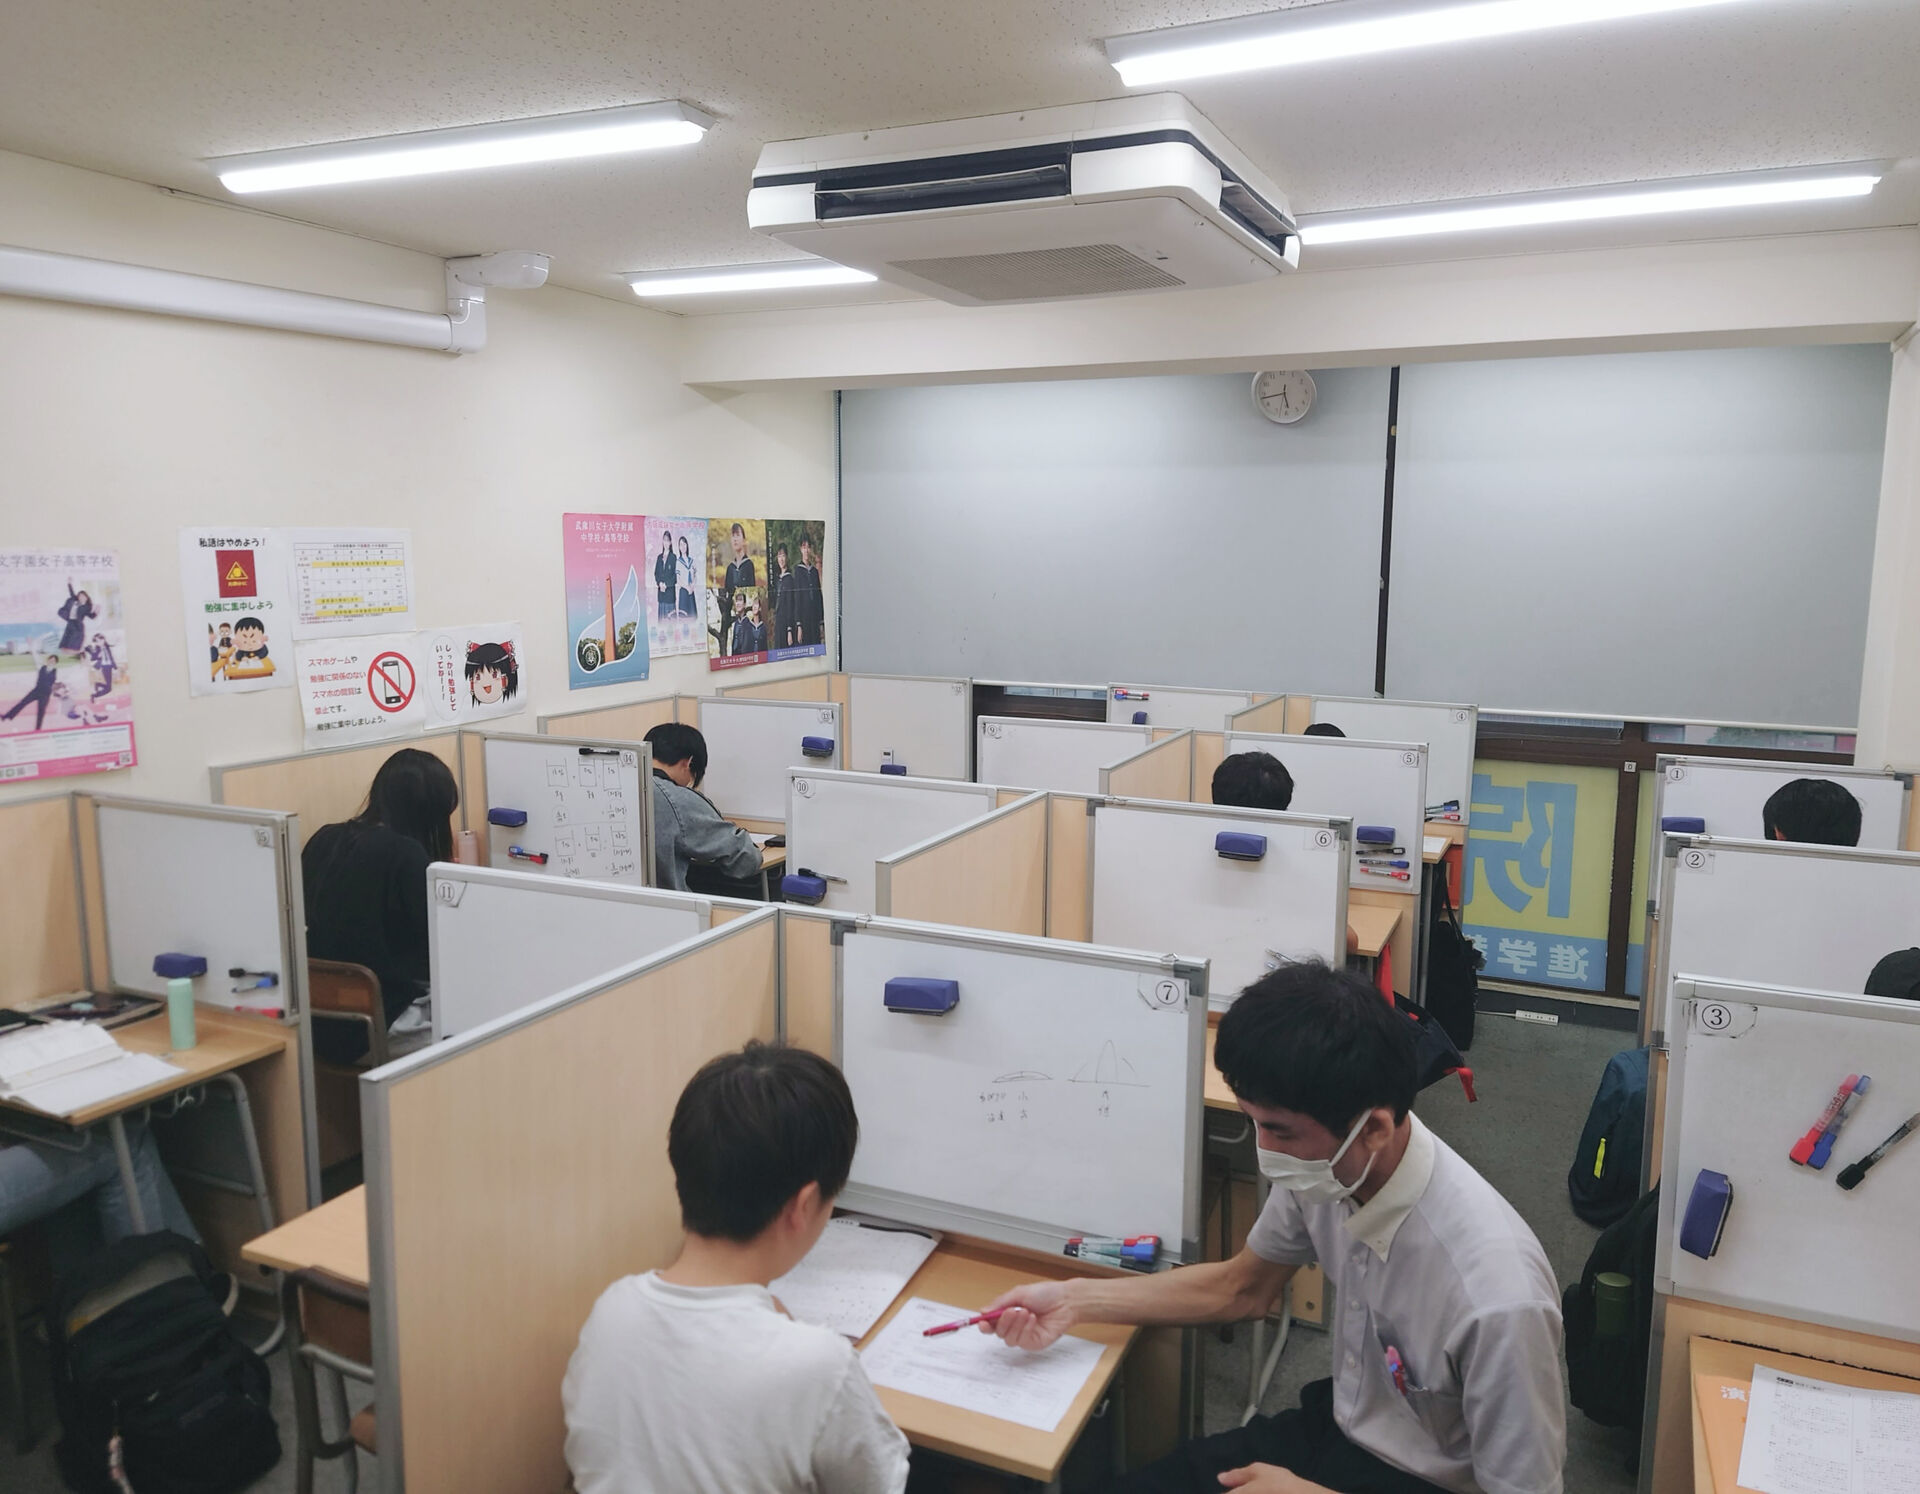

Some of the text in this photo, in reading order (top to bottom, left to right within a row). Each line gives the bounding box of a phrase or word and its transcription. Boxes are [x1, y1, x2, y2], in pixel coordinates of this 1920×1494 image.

[204, 601, 273, 613] 勉強に集中しよう
[308, 655, 358, 667] スマホゲームや
[310, 671, 367, 683] 勉強に関係のない
[445, 644, 457, 712] しっかり勉強して
[314, 704, 348, 716] 禁止です。
[317, 715, 387, 732] 勉強に集中しましょう。
